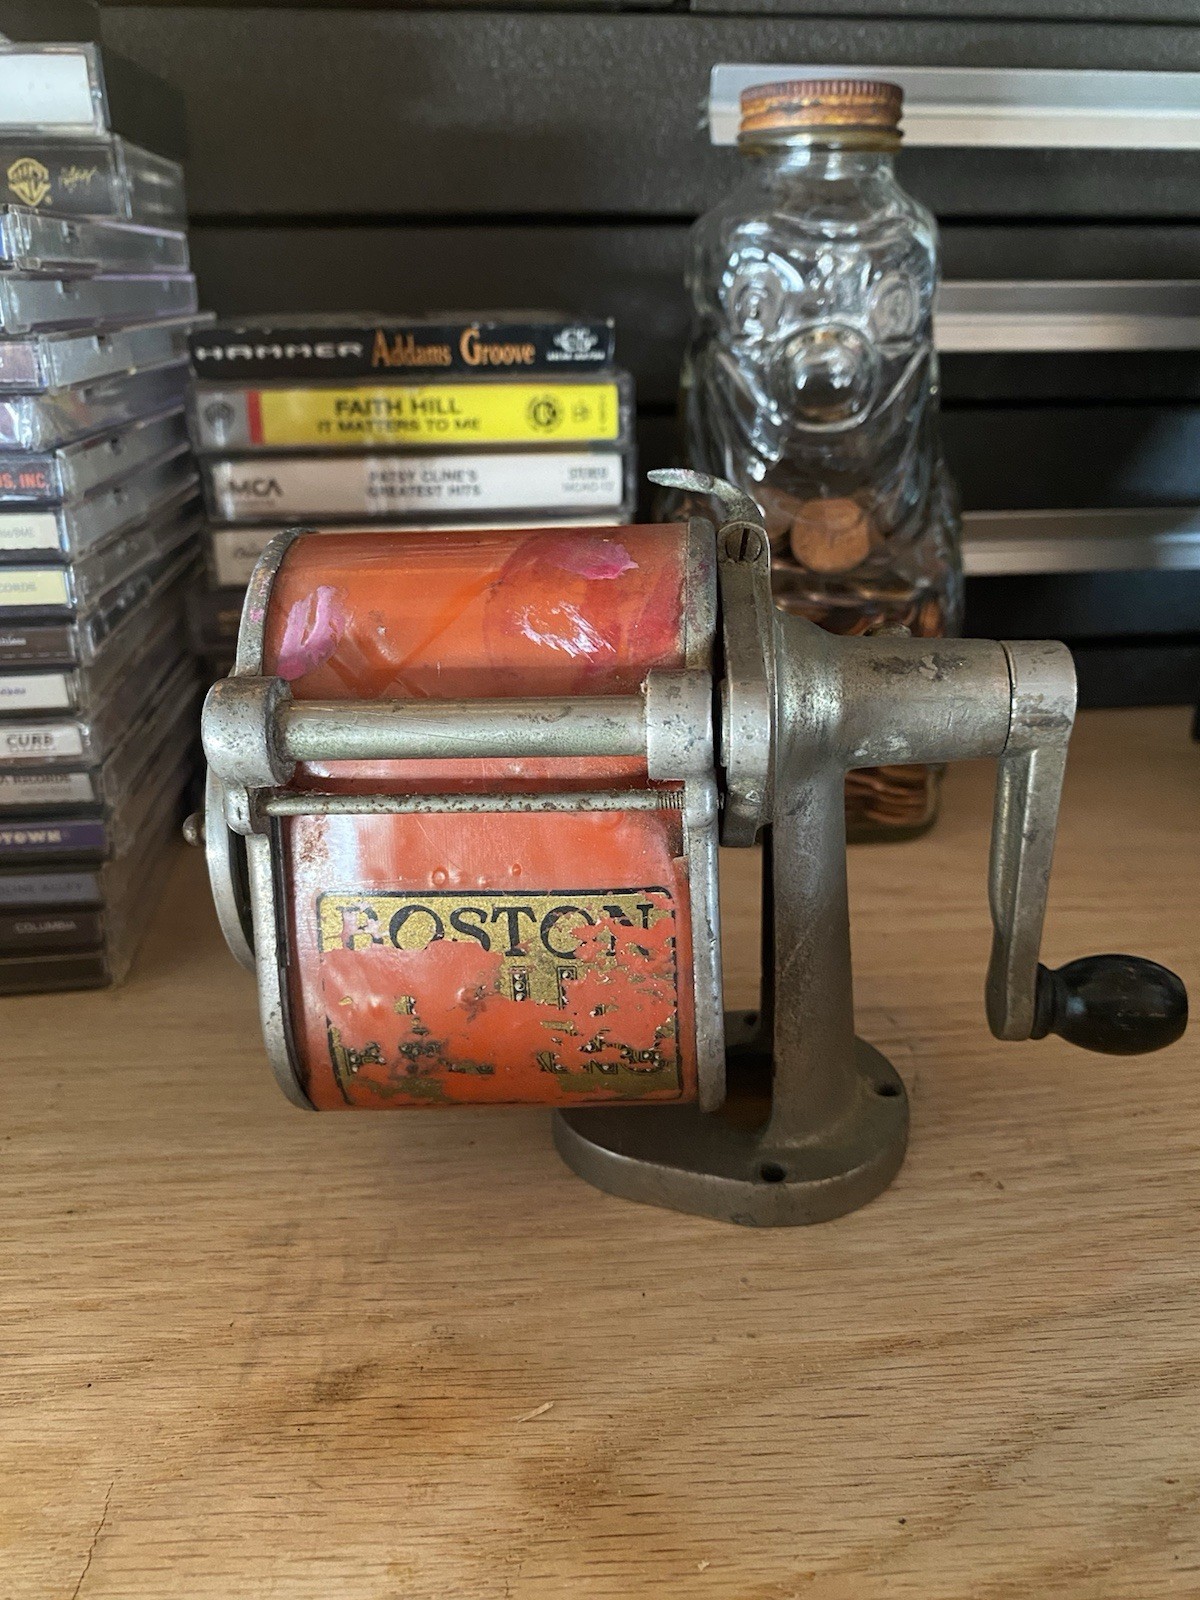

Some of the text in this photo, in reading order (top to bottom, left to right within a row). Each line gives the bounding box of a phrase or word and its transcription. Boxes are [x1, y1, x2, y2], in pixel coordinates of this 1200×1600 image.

[195, 327, 535, 367] HAMMER Addams Groove
[334, 397, 462, 416] FAITH HILL
[317, 417, 481, 433] IT MATTERS TO ME
[368, 469, 416, 483] PATSY
[229, 477, 283, 497] MCA
[366, 481, 482, 498] GREATEST HITS
[6, 733, 54, 748] CURB
[0, 829, 62, 846] TOWN
